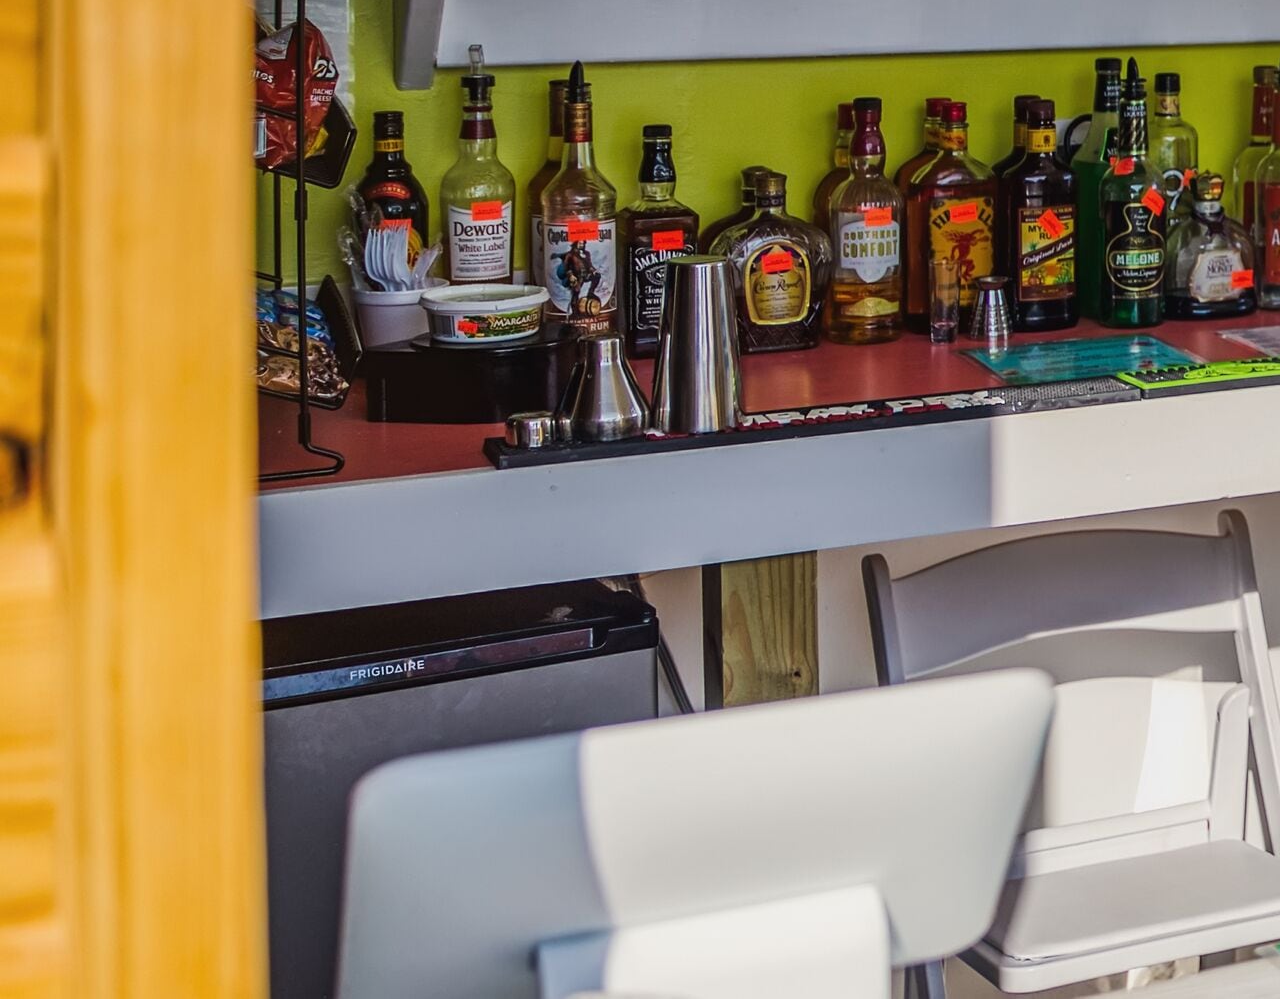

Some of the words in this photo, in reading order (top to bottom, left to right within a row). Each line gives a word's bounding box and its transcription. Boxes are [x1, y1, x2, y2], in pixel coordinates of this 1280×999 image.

[932, 207, 993, 230] FIRLL
[453, 220, 509, 237] Dewar's
[548, 228, 569, 245] Capta
[597, 228, 612, 242] gan
[843, 230, 897, 241] SOUTHERN
[1039, 232, 1060, 240] RU
[843, 240, 898, 259] COMFORT
[1023, 248, 1056, 266] Original
[1056, 238, 1074, 252] Dark
[635, 253, 658, 271] JACK
[1116, 252, 1160, 266] MELONE
[590, 321, 610, 332] RUM
[349, 659, 426, 681] FRIGIDAIRE
